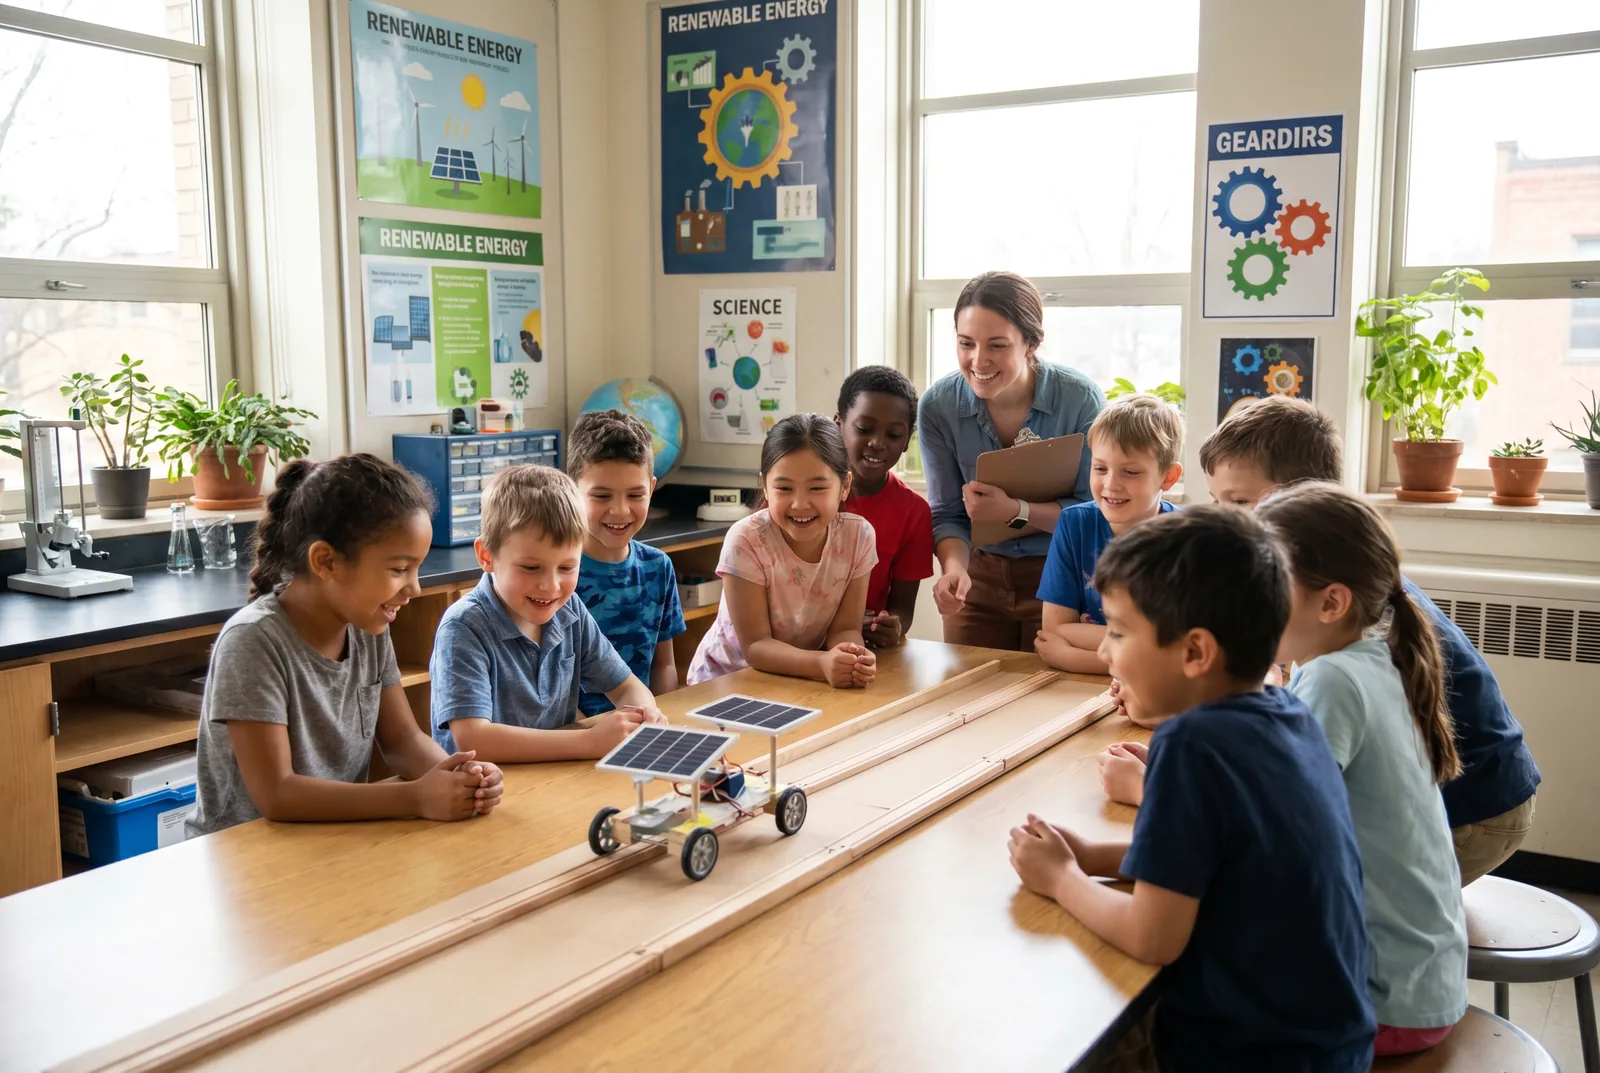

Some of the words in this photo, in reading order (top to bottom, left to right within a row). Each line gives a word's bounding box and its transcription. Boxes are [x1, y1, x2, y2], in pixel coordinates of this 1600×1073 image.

[668, 4, 761, 33] RENEWABLE
[765, 0, 829, 21] ENERGY
[367, 10, 464, 51] RENEWABLE
[468, 36, 522, 64] ENERGY
[1216, 125, 1333, 153] GEARDIRS
[380, 227, 473, 253] RENEWABLE
[476, 236, 528, 257] ENERGY
[713, 299, 782, 315] SCIENCE
